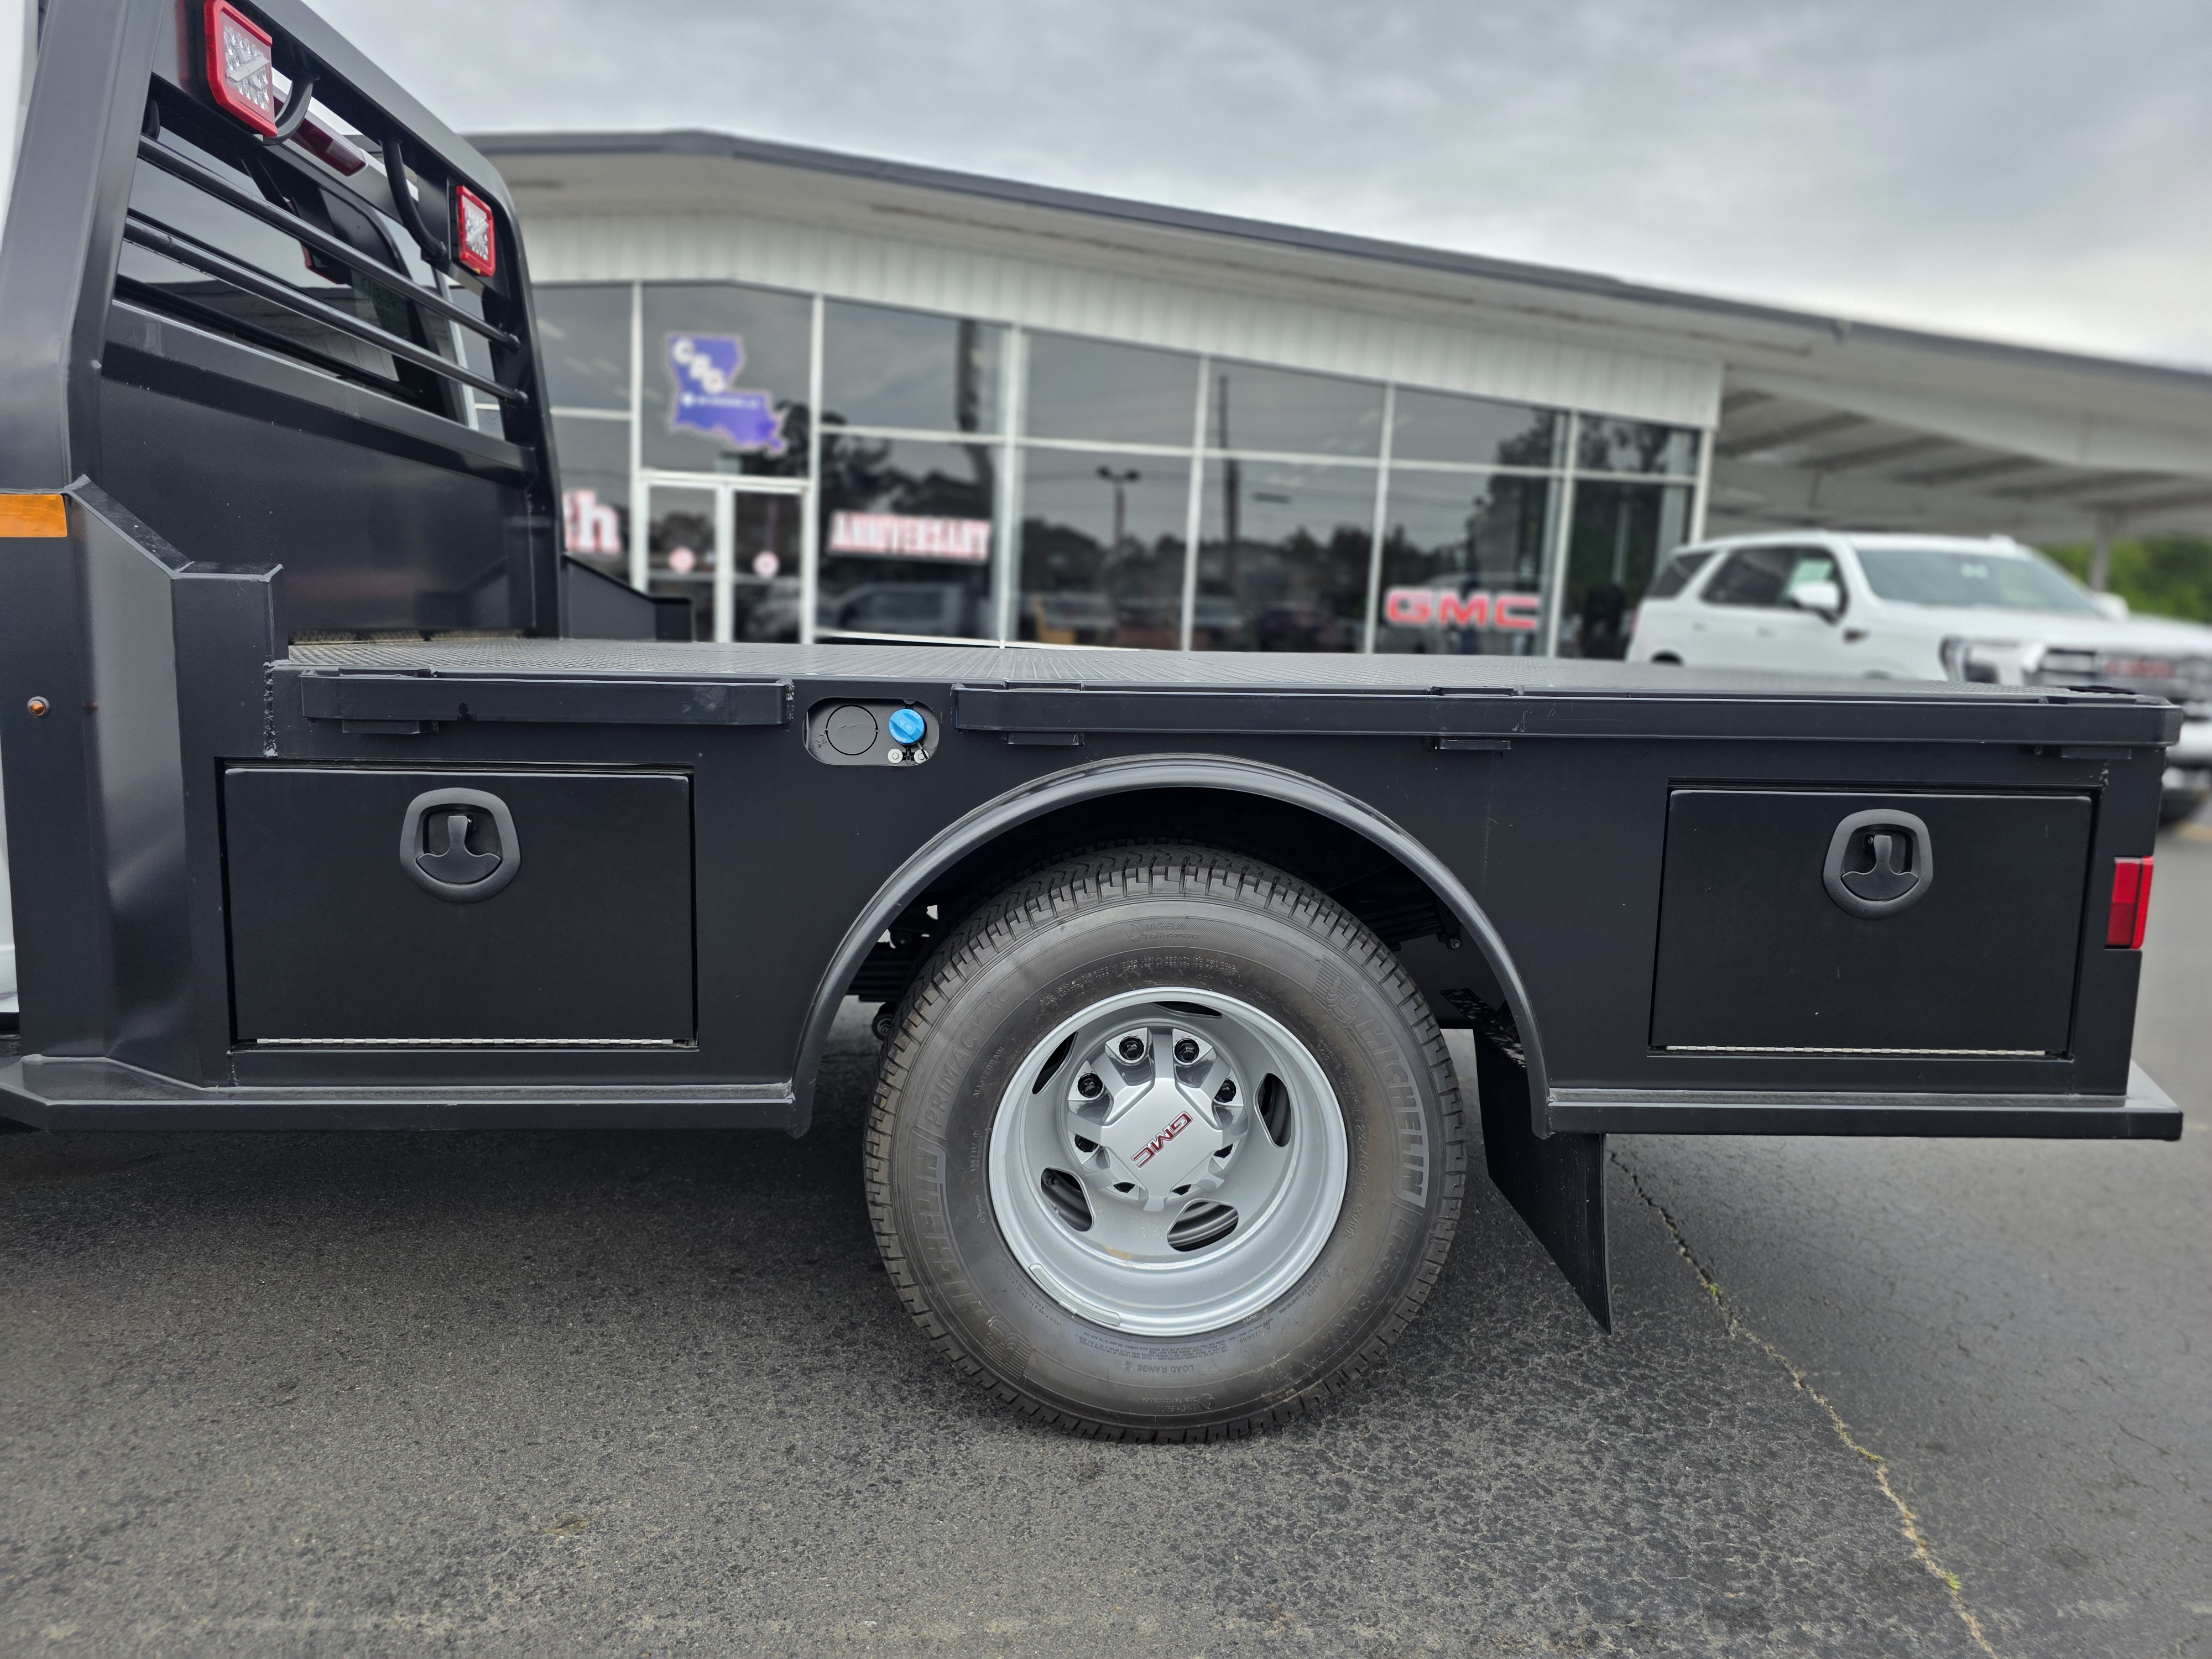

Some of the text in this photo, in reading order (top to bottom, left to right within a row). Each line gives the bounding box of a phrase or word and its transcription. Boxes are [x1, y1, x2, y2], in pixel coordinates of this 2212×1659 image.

[1386, 586, 1541, 629] GMC
[909, 710, 921, 719] DEF
[924, 987, 1011, 1126] PRIMACY XC
[973, 1046, 1005, 1098] ALL TERRAIN
[1355, 1018, 1424, 1197] MICHELIN
[1130, 1110, 1193, 1168] GMC
[1306, 1276, 1325, 1297] DANGER
[1136, 1364, 1167, 1373] RANGE
[1171, 1364, 1195, 1373] LOAD
